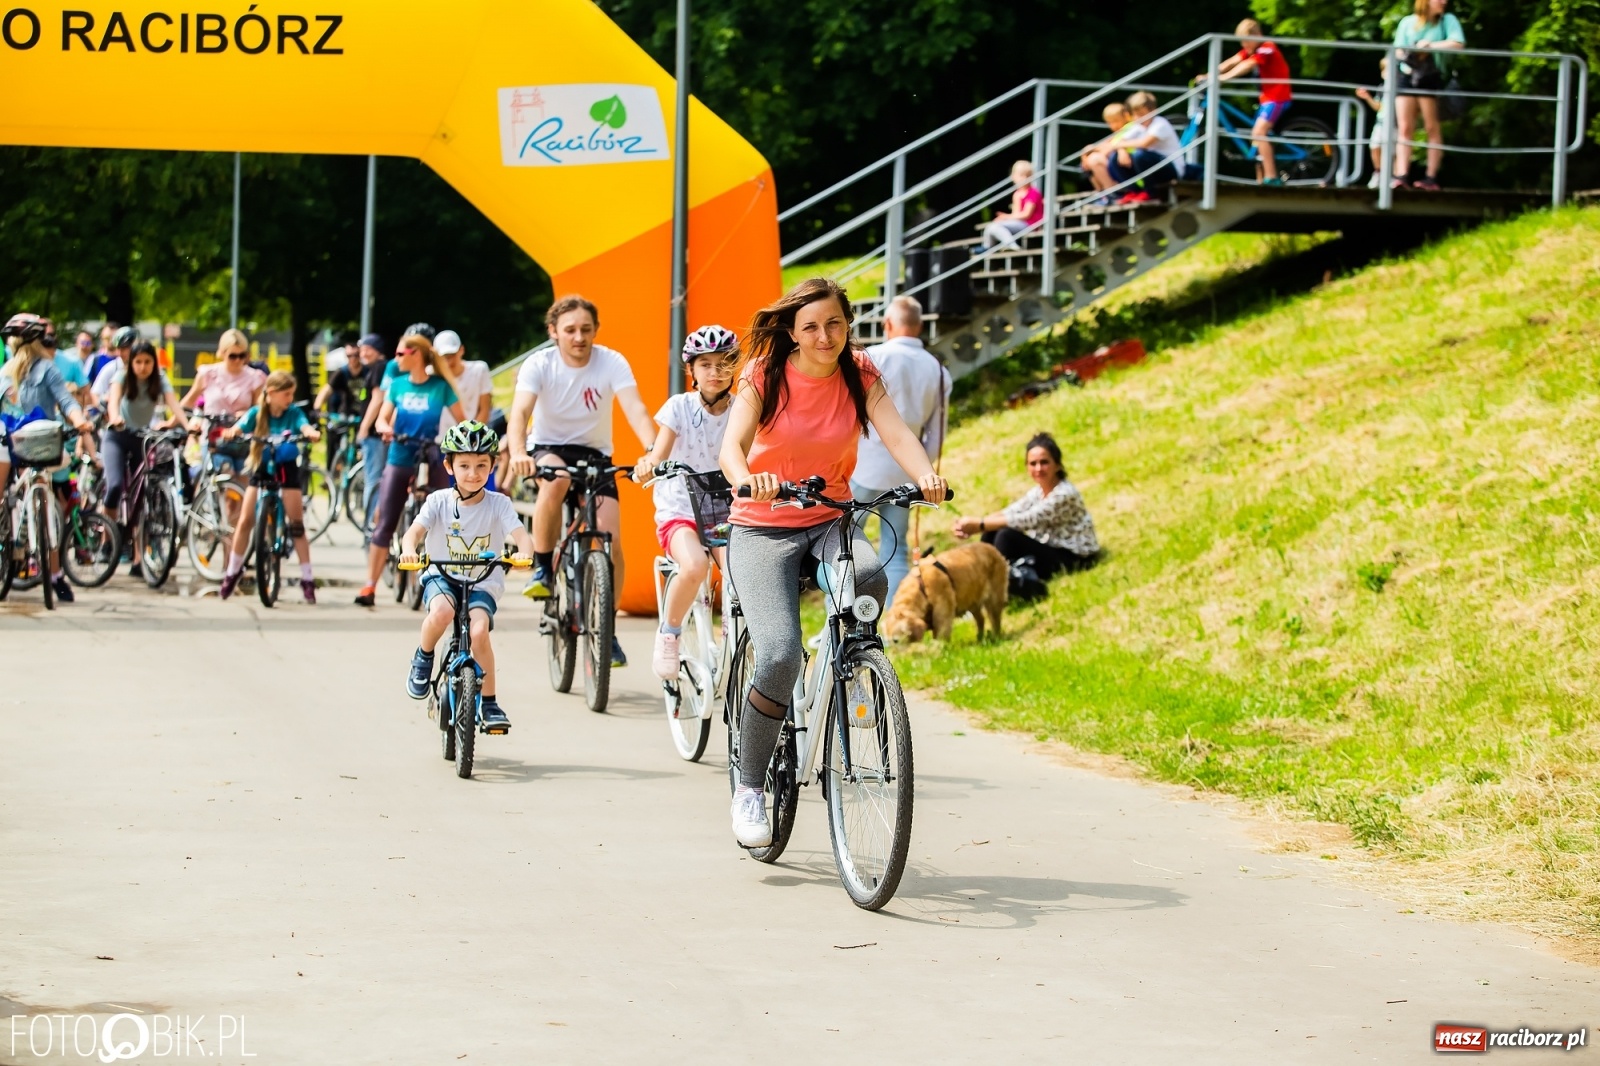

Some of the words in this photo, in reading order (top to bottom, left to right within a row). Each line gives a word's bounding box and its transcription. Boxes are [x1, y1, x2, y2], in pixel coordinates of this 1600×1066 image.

[2, 8, 41, 50] O
[61, 4, 344, 55] RACIBÓRZ
[519, 117, 657, 163] Racibórz
